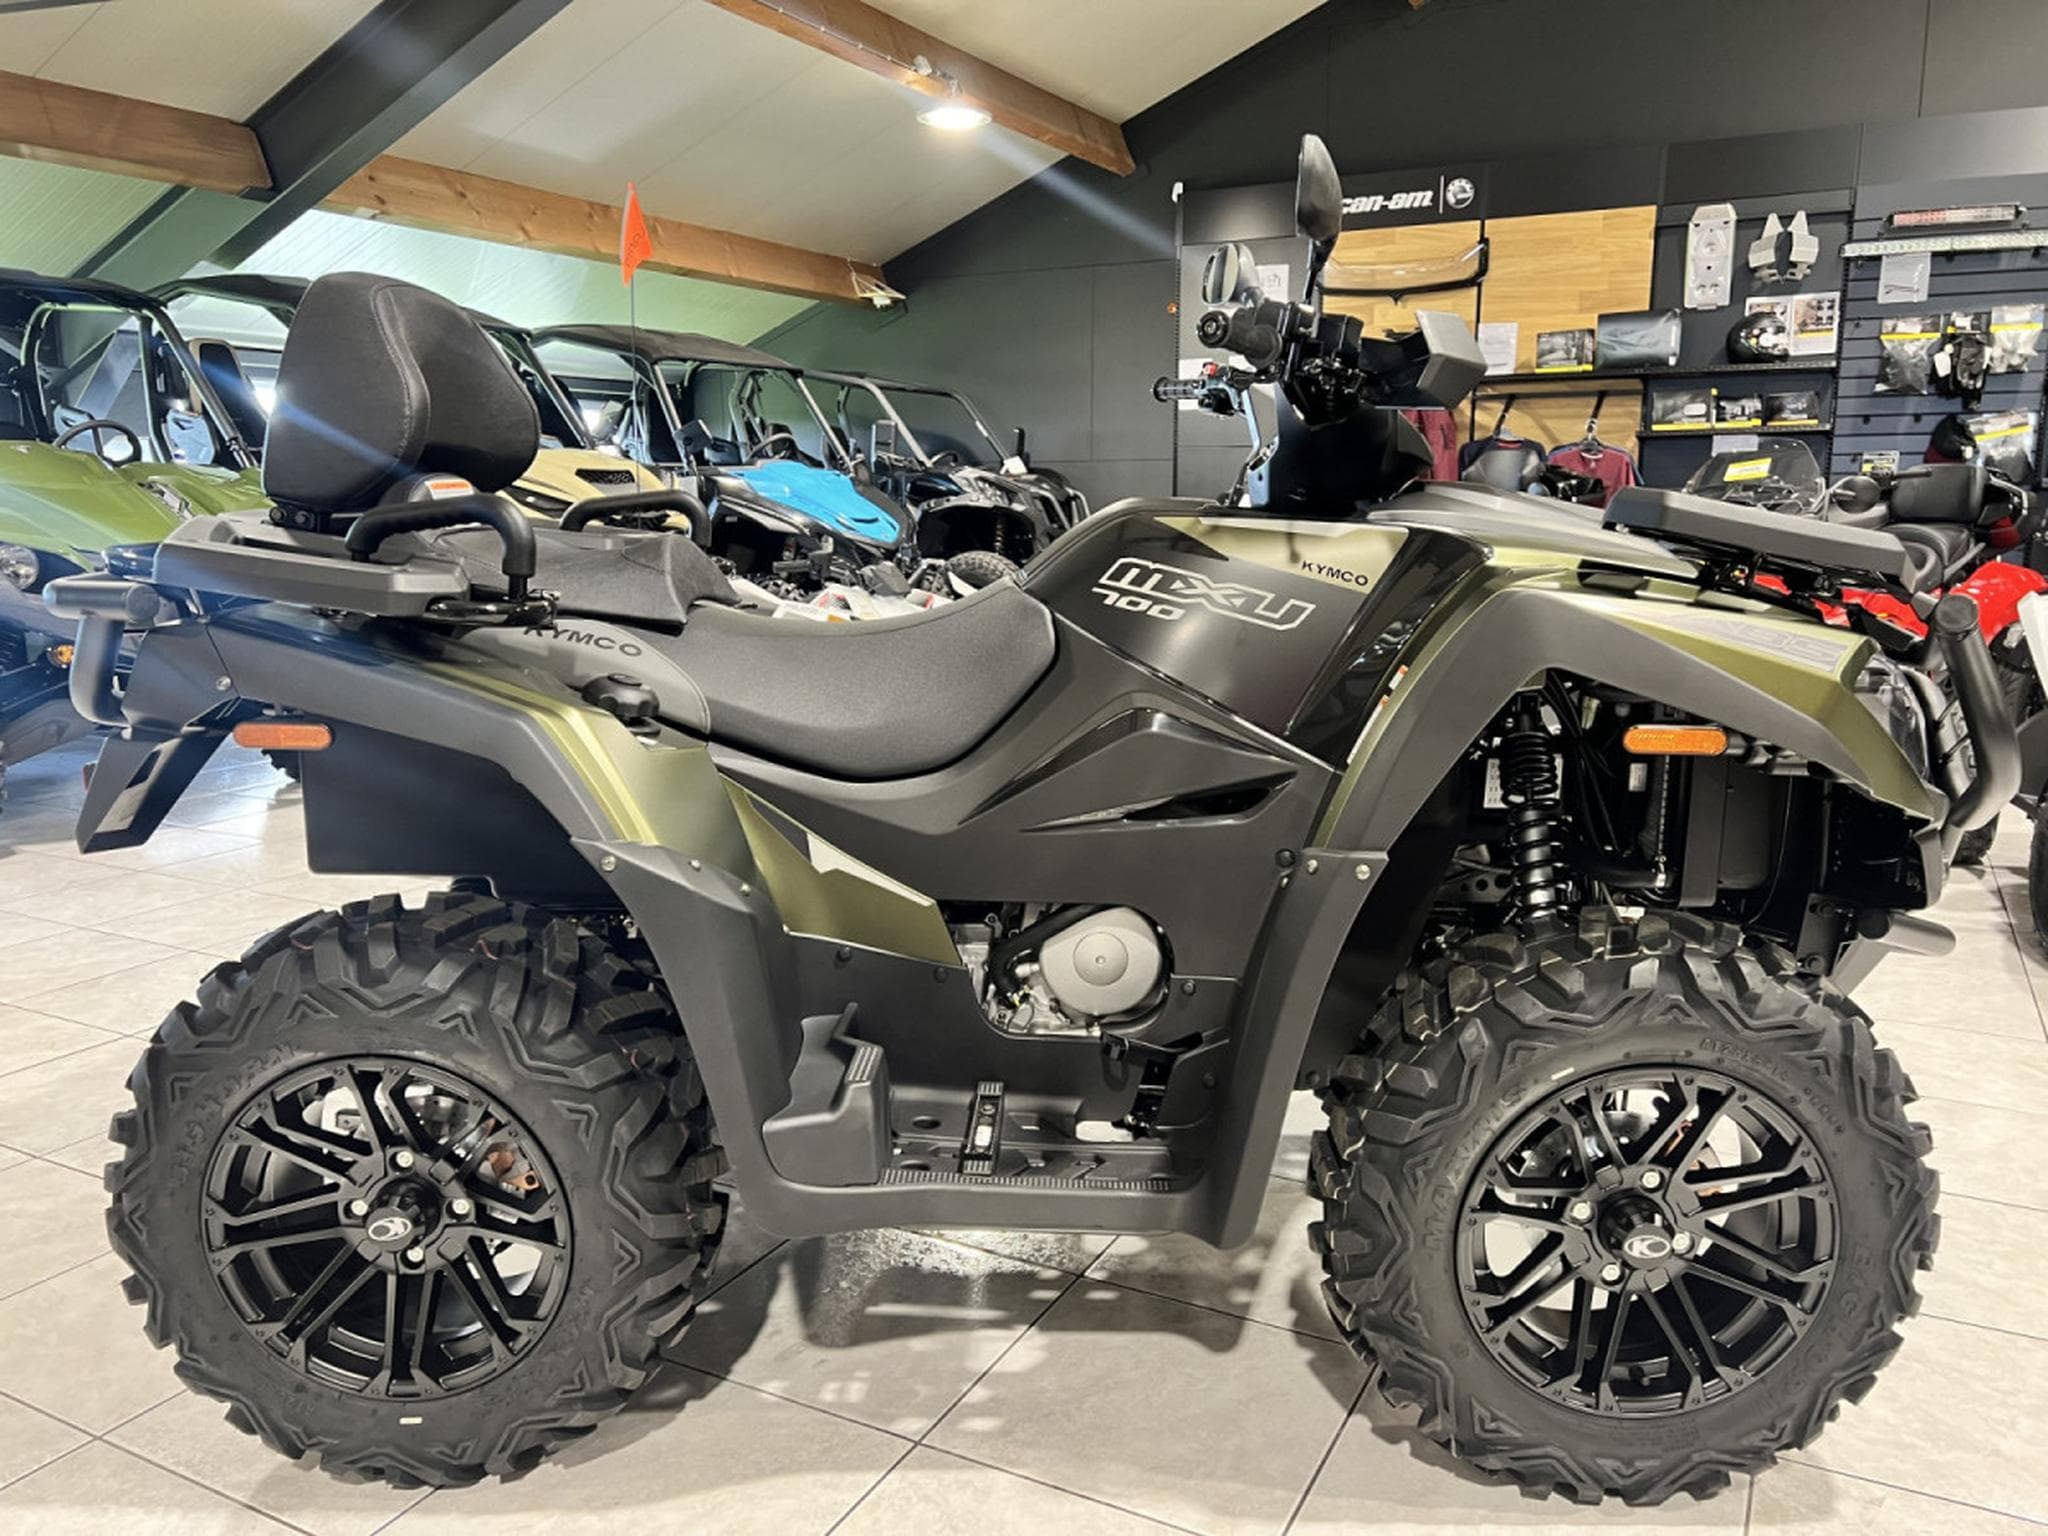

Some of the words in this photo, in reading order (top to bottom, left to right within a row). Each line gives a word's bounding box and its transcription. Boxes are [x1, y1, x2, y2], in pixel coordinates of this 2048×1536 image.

[1341, 190, 1434, 215] can-am
[1301, 559, 1370, 587] KYMCO
[1091, 587, 1187, 621] 700
[1098, 556, 1317, 632] MXU
[523, 624, 643, 657] KYMCO
